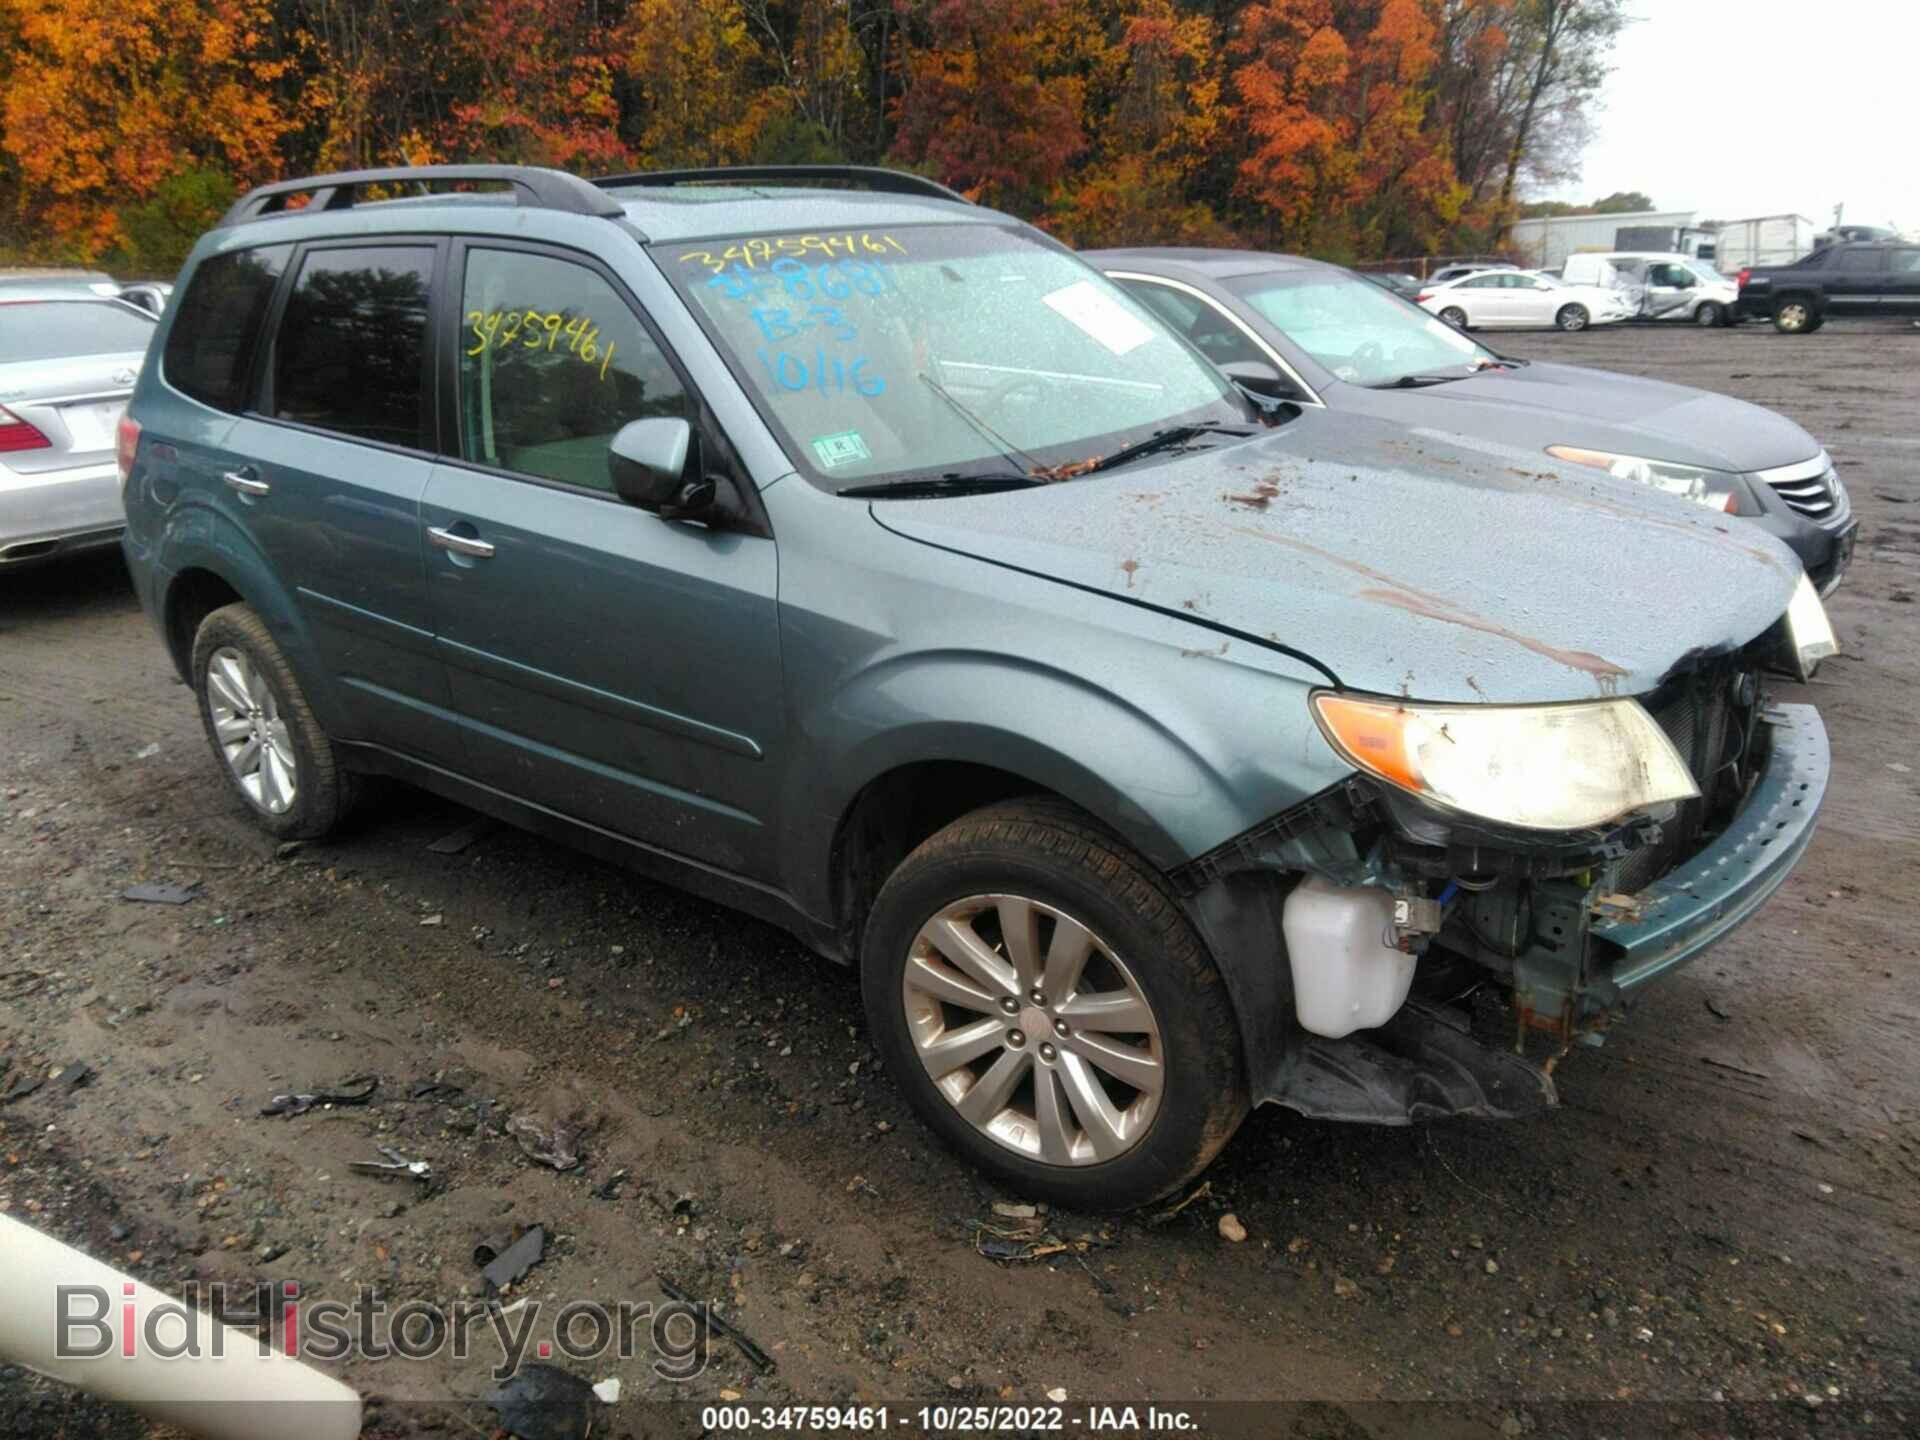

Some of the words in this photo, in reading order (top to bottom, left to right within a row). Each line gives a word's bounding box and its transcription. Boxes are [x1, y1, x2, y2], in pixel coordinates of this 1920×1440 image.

[679, 233, 909, 274] 34759461
[467, 309, 616, 382] 34759461
[751, 303, 858, 342] B-3
[756, 345, 888, 398] 10/16
